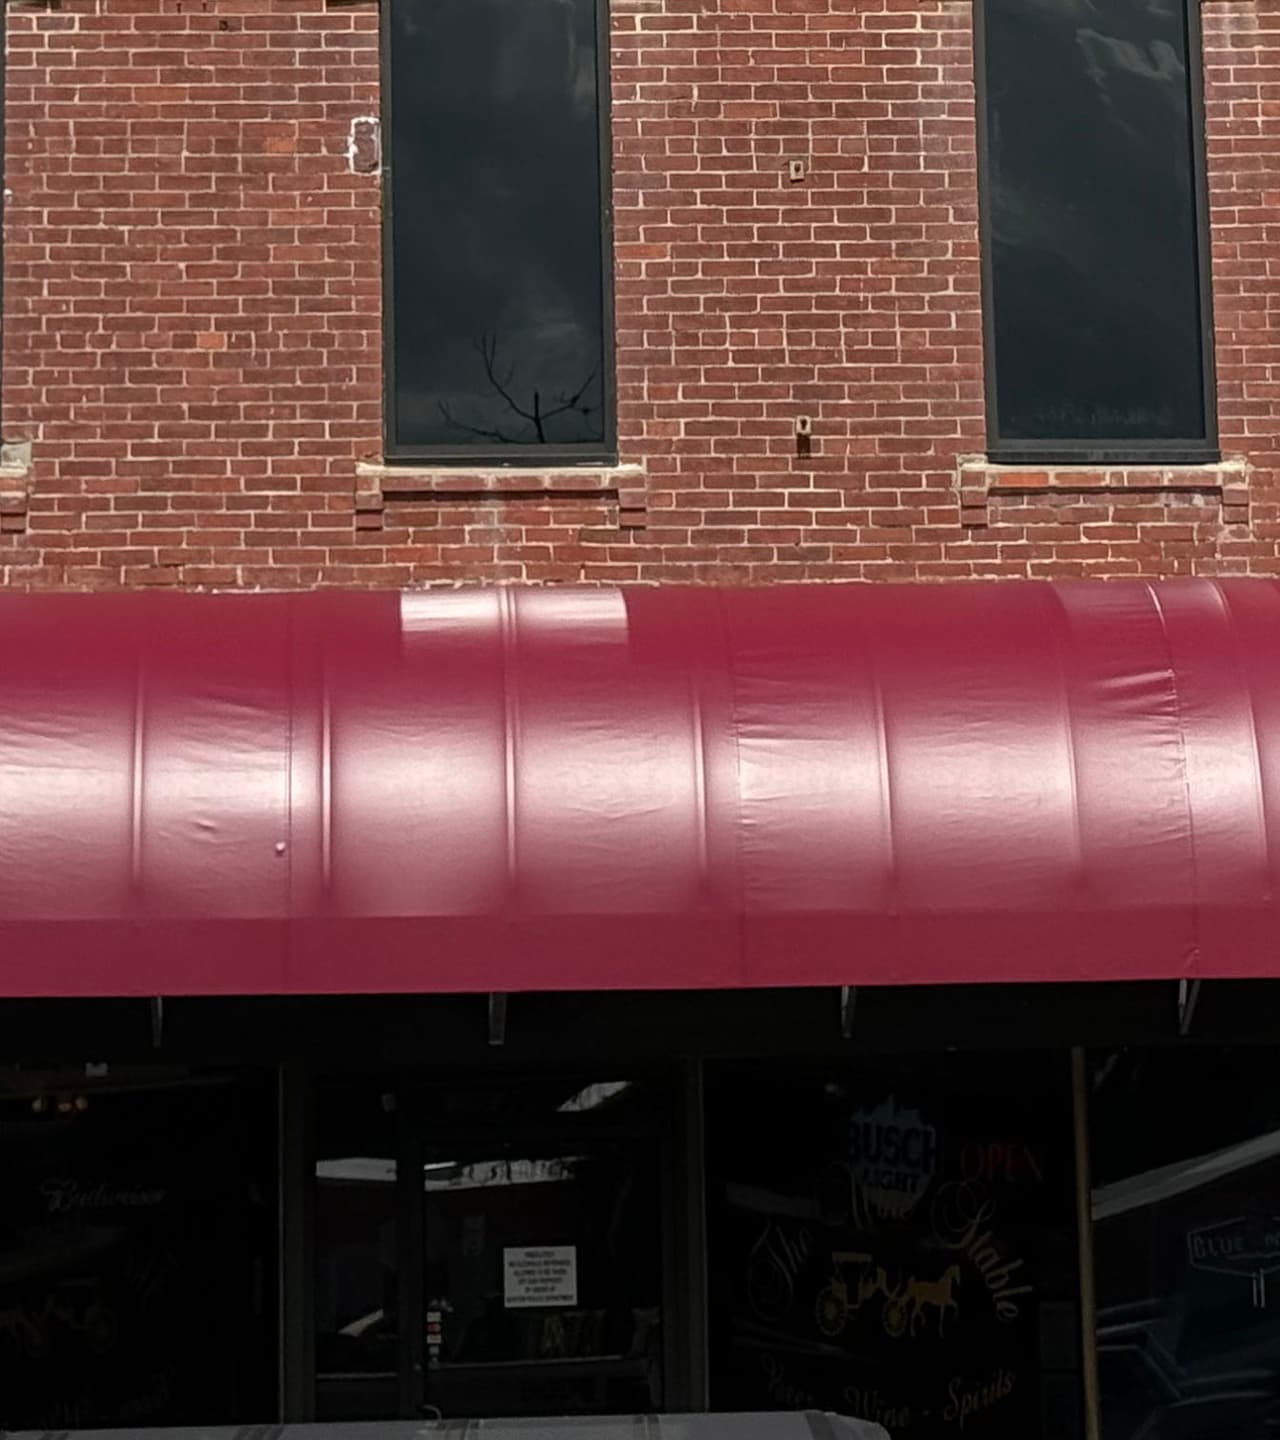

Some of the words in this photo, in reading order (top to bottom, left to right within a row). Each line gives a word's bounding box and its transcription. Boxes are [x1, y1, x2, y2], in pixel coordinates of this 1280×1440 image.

[846, 1121, 937, 1174] BUSCH
[960, 1143, 1043, 1184] OPEN
[929, 1178, 1033, 1323] Stable
[942, 1367, 1017, 1432] Spirits
